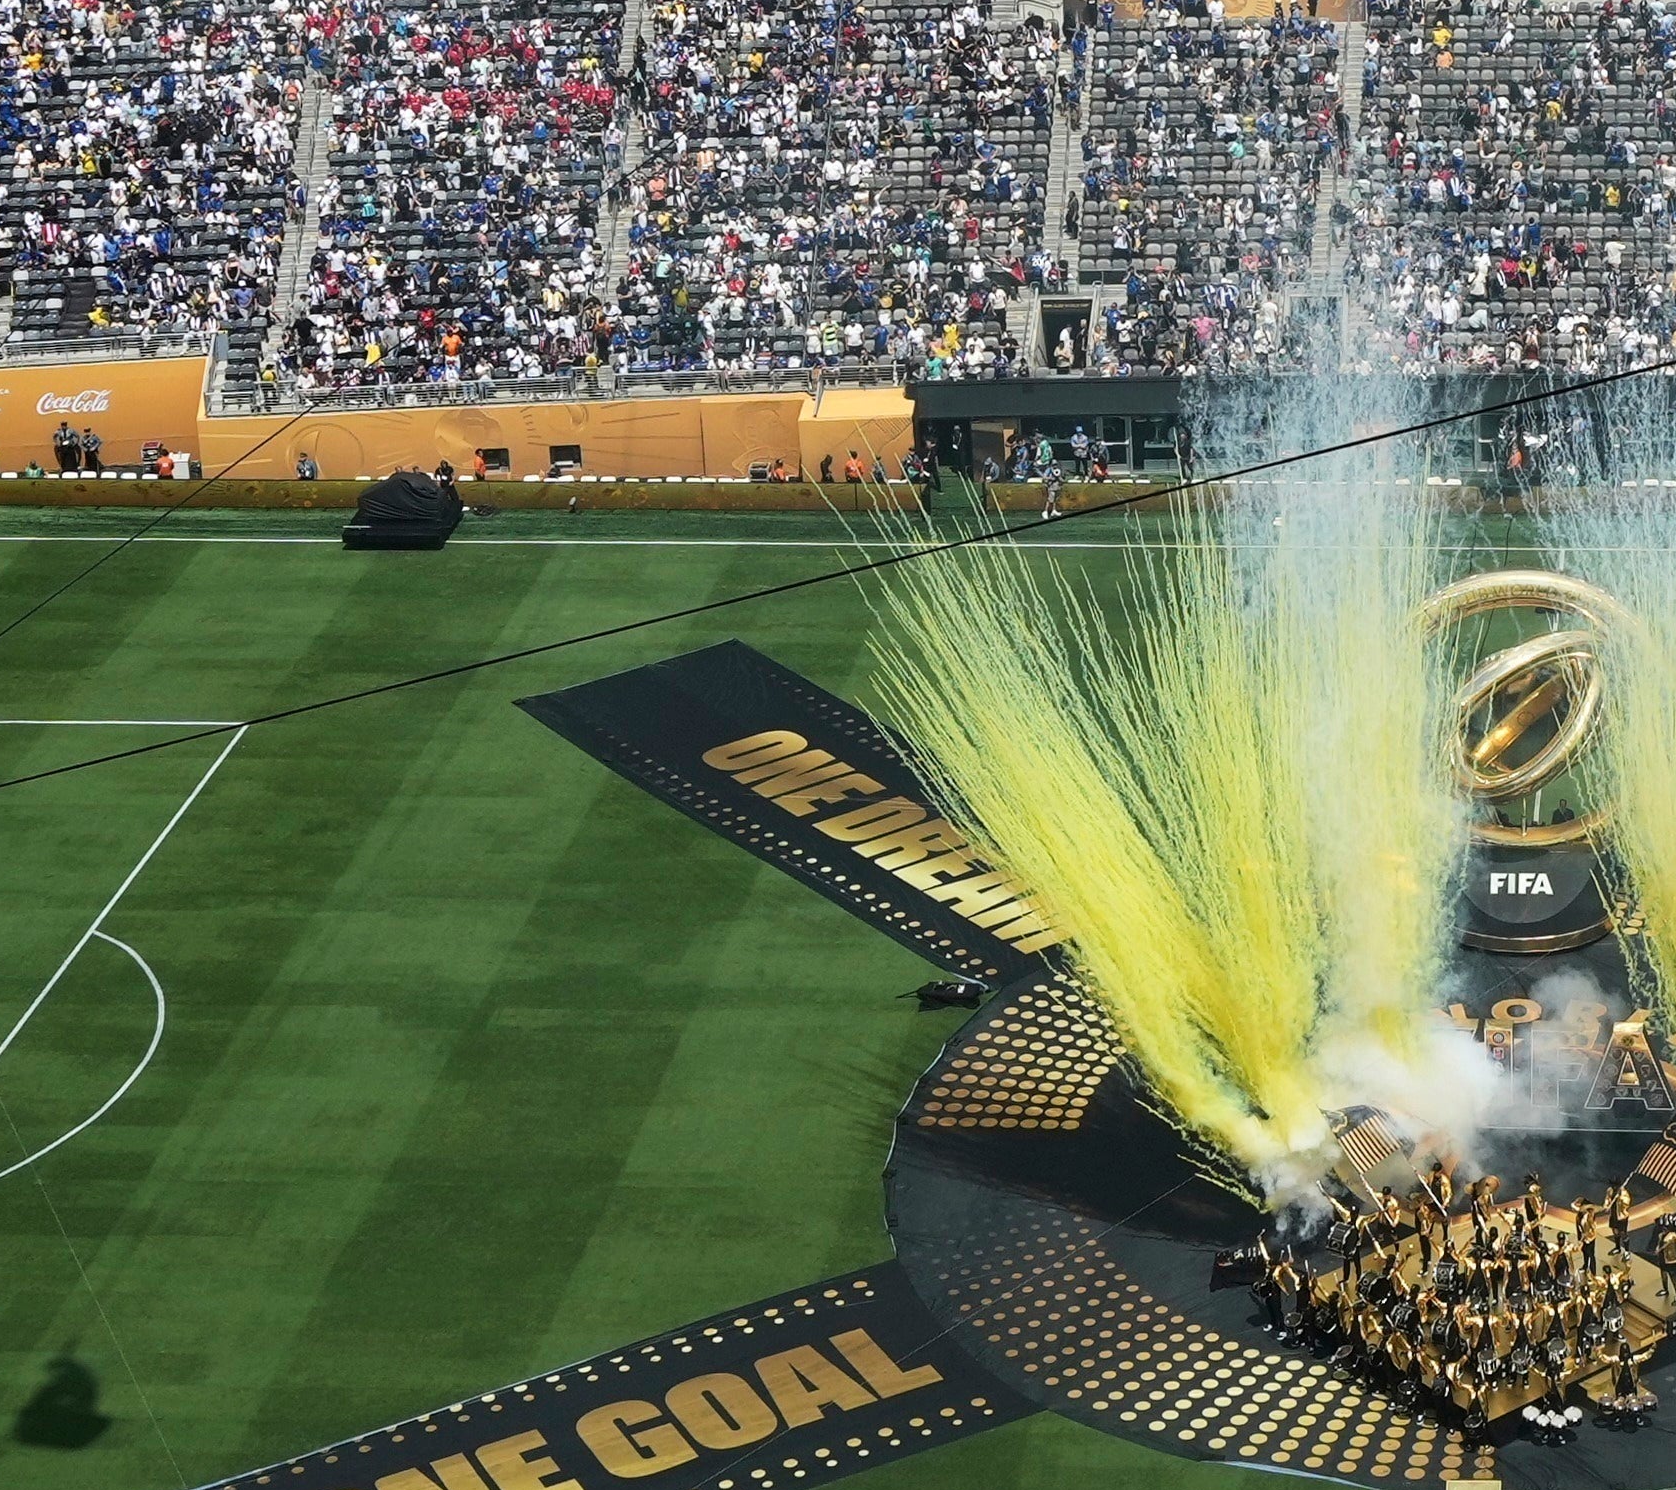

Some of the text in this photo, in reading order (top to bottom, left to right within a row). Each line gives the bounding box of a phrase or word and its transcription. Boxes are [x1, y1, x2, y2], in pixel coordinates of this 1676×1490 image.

[36, 390, 113, 415] Coca-Cola
[701, 730, 887, 817] ONE
[1489, 872, 1554, 895] FIFA
[576, 1326, 944, 1481] GOAL
